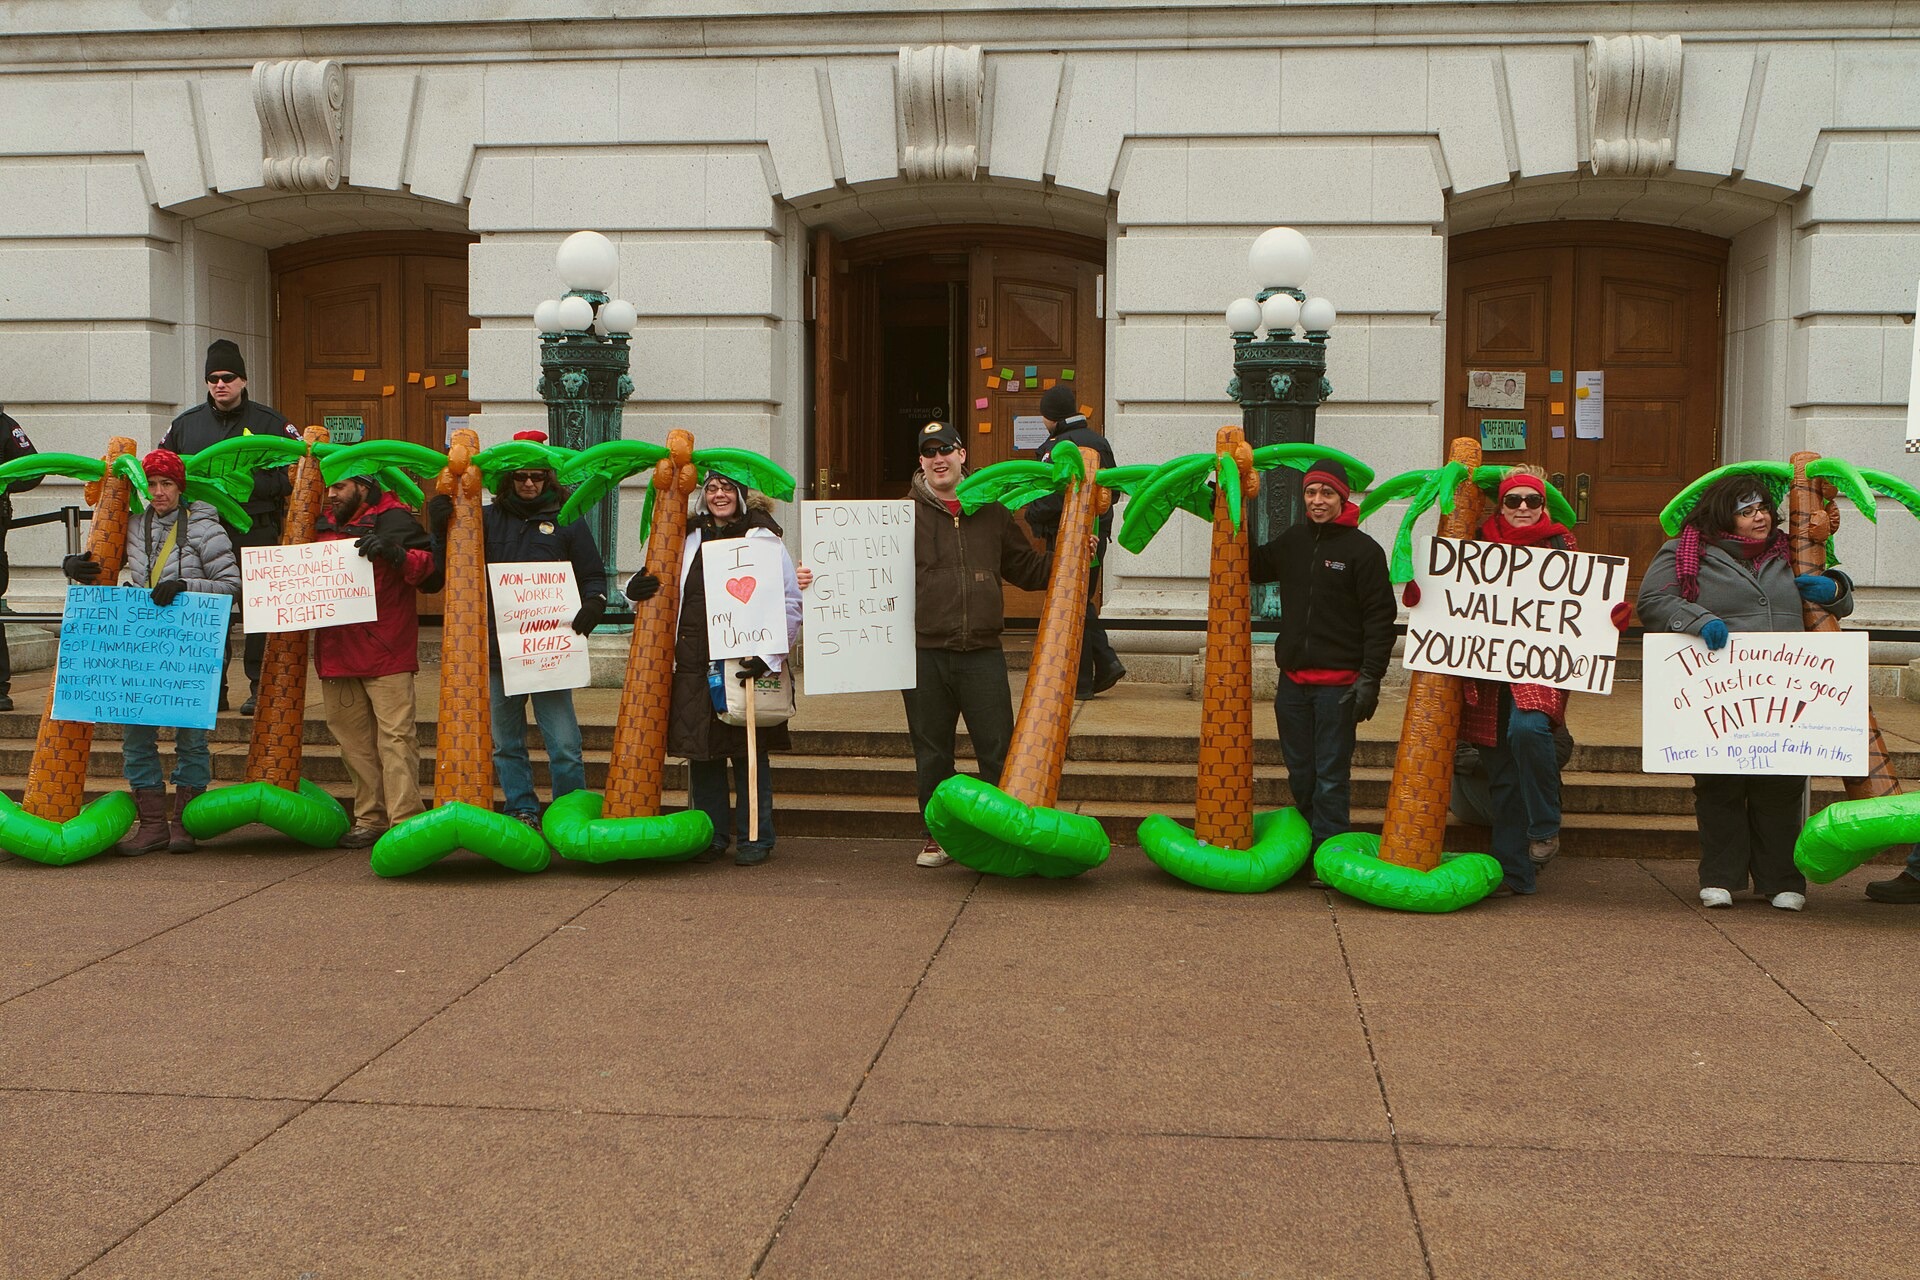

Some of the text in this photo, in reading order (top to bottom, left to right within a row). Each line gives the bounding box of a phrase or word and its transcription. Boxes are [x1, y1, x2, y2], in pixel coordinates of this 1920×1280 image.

[339, 417, 362, 430] ENTRANCE
[1498, 421, 1524, 435] ENTRANCE
[815, 504, 912, 526] FOX NEWS
[245, 543, 339, 565] THIS IS AN
[728, 545, 754, 571] I
[813, 535, 900, 564] CAN'T EVEN
[245, 556, 346, 581] UNREASONABLE
[499, 572, 566, 586] NON-UNION
[1428, 536, 1626, 601] DROP OUT
[269, 572, 354, 592] RESTRICTION
[813, 566, 893, 600] GET IN
[68, 587, 121, 603] FEMALE
[198, 597, 219, 610] WI
[249, 586, 373, 608] OF MY CONSTITUTIONAL
[514, 587, 564, 603] WORKER
[64, 606, 221, 628] CITIZEN SEEKS MALE
[277, 603, 336, 626] RIGHTS
[504, 605, 570, 623] SUPPORTING
[712, 612, 732, 628] my
[813, 596, 898, 622] THE RIGHT
[1445, 589, 1582, 639] WALKER
[63, 622, 221, 644] OR FEMALE COURAGEOUS
[520, 619, 560, 635] UNION
[724, 627, 773, 649] Union
[61, 639, 219, 658] GOP LAWMAKER(S) MUST
[523, 635, 572, 654] RIGHTS
[817, 625, 894, 655] STATE
[59, 656, 220, 675] BE HONORABLE AND HAVE
[522, 658, 536, 666] THIS
[1664, 638, 1835, 676] The Foundation
[121, 676, 206, 691] WILLINGNESS
[1674, 668, 1853, 710] of Justice is good
[58, 690, 72, 700] TO
[74, 690, 117, 702] DISCUSS
[125, 692, 202, 708] NEGOTIATE
[95, 705, 144, 718] A PLUS!
[1704, 696, 1807, 739] FAITH!
[1659, 746, 1699, 764] There
[1727, 745, 1742, 758] no
[1749, 740, 1777, 759] good
[1782, 738, 1812, 755] faith
[1817, 744, 1828, 757] in
[1830, 746, 1853, 763] this
[1737, 755, 1774, 770] BILL
